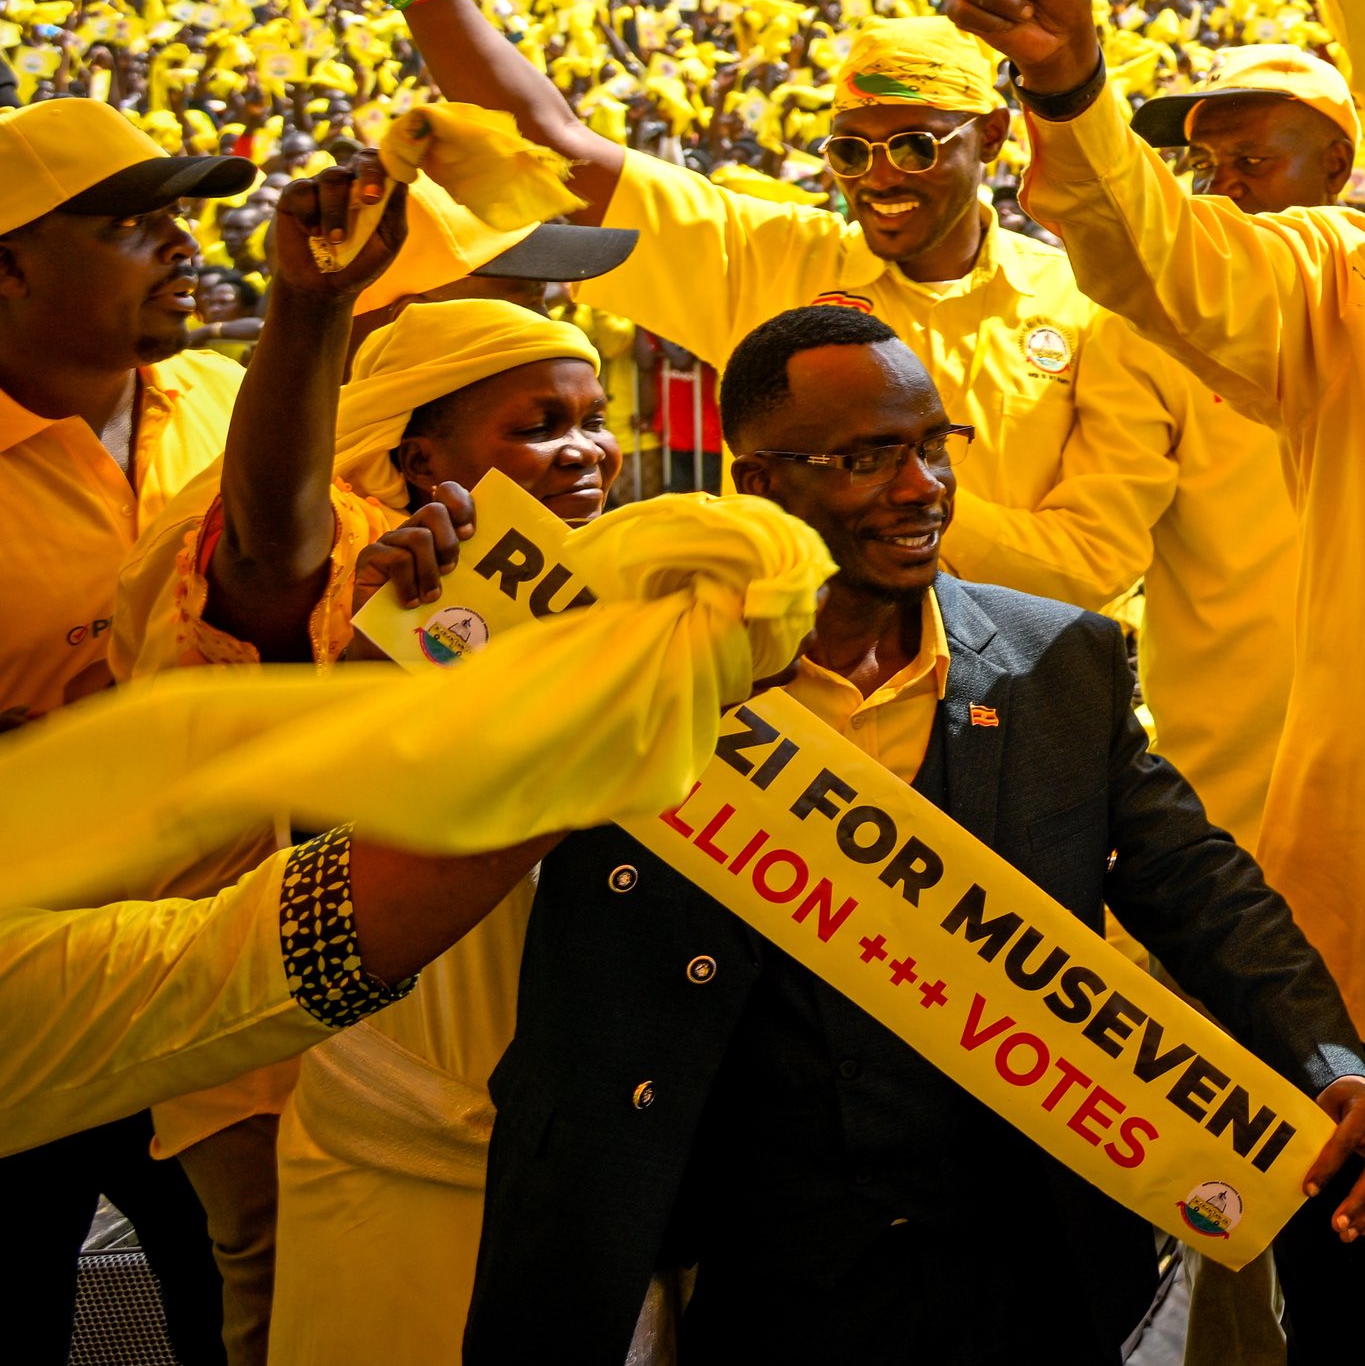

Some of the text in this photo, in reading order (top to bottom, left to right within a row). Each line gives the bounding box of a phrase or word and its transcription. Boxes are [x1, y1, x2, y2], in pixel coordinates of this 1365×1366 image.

[659, 780, 859, 943] LLION
[959, 992, 1160, 1169] VOTES
[789, 767, 944, 909] FOR
[940, 883, 1297, 1174] MUSEVENI
